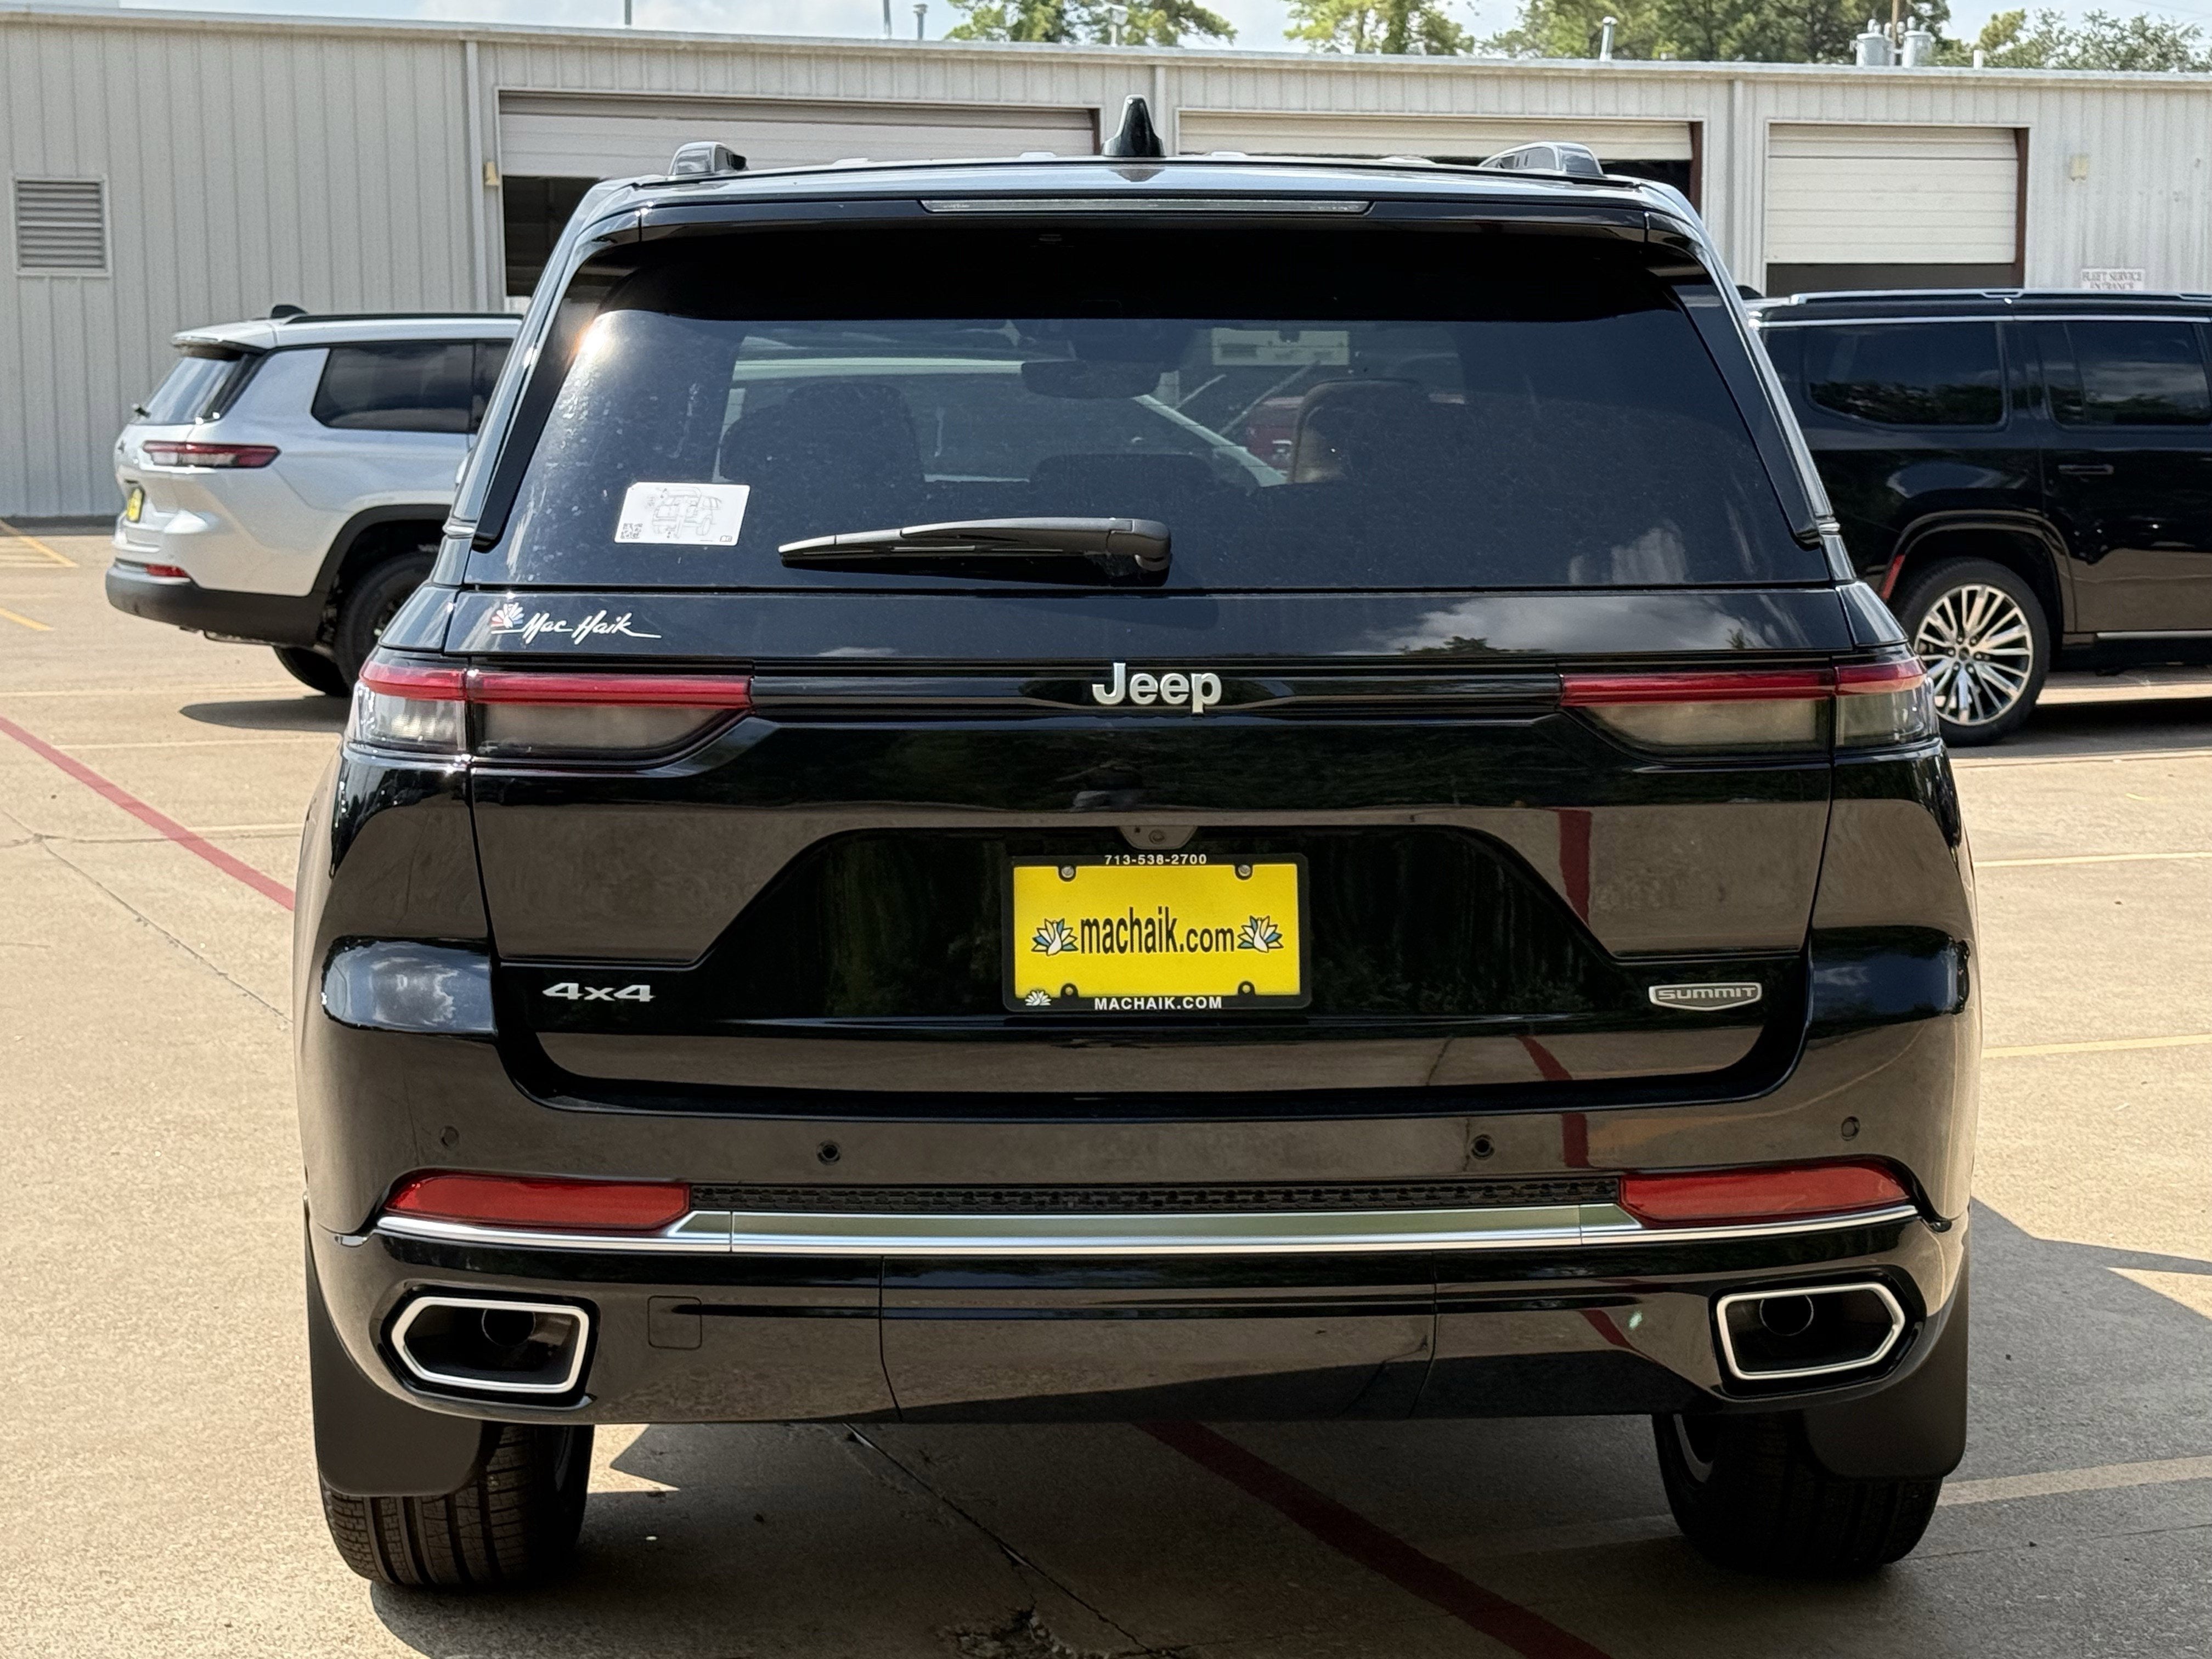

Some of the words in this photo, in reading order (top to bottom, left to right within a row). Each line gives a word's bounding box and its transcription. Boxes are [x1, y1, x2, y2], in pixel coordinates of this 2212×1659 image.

[491, 612, 574, 644] Mac
[571, 610, 662, 645] Haik
[1092, 662, 1222, 713] Jeep
[1104, 854, 1207, 865] 713-538-2700
[1080, 906, 1234, 954] machaik.com
[542, 983, 656, 1002] 4x4
[1658, 987, 1756, 1000] SUMMIT
[1094, 996, 1222, 1011] MACHAIK.COM
